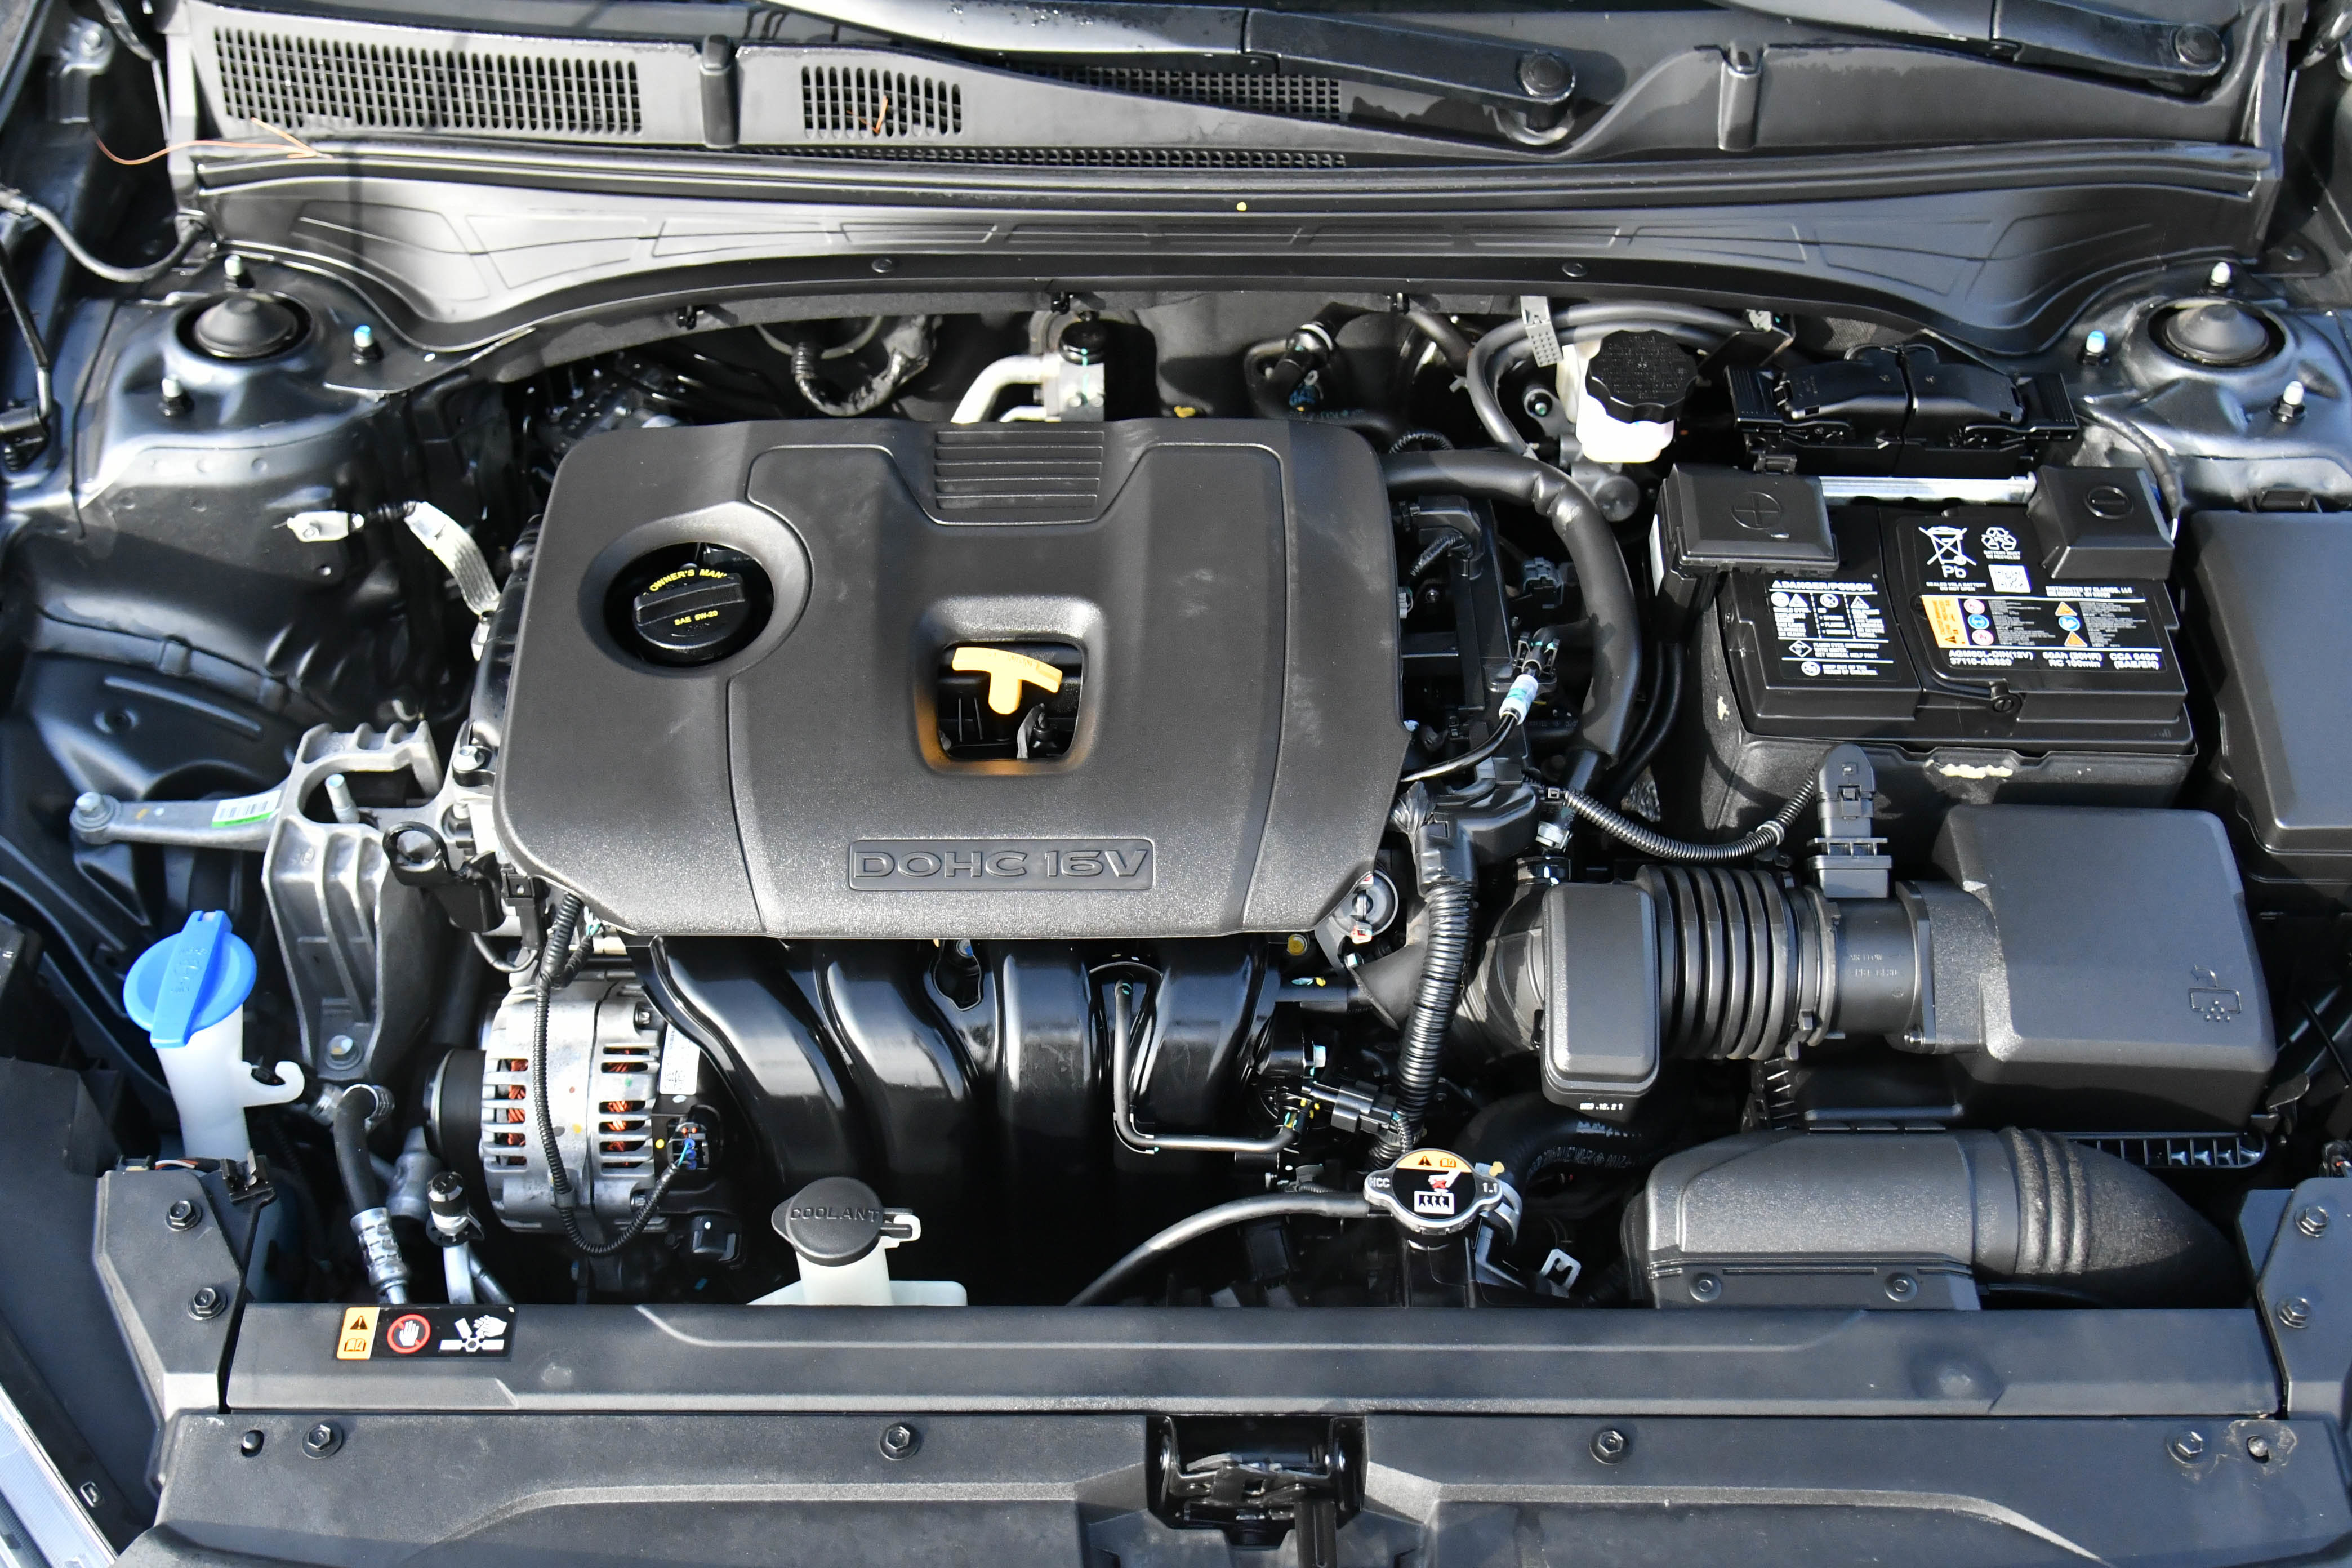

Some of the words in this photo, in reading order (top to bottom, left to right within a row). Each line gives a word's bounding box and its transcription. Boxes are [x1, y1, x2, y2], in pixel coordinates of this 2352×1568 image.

[1942, 565, 1966, 578] Pb
[649, 569, 695, 591] OWNER'S
[674, 616, 692, 625] SAE
[694, 610, 718, 621] 5W-20
[853, 850, 1028, 879] DOHC
[1045, 850, 1148, 878] 16V
[1482, 1182, 1498, 1193] 1.1
[790, 1206, 879, 1222] COOLANT
